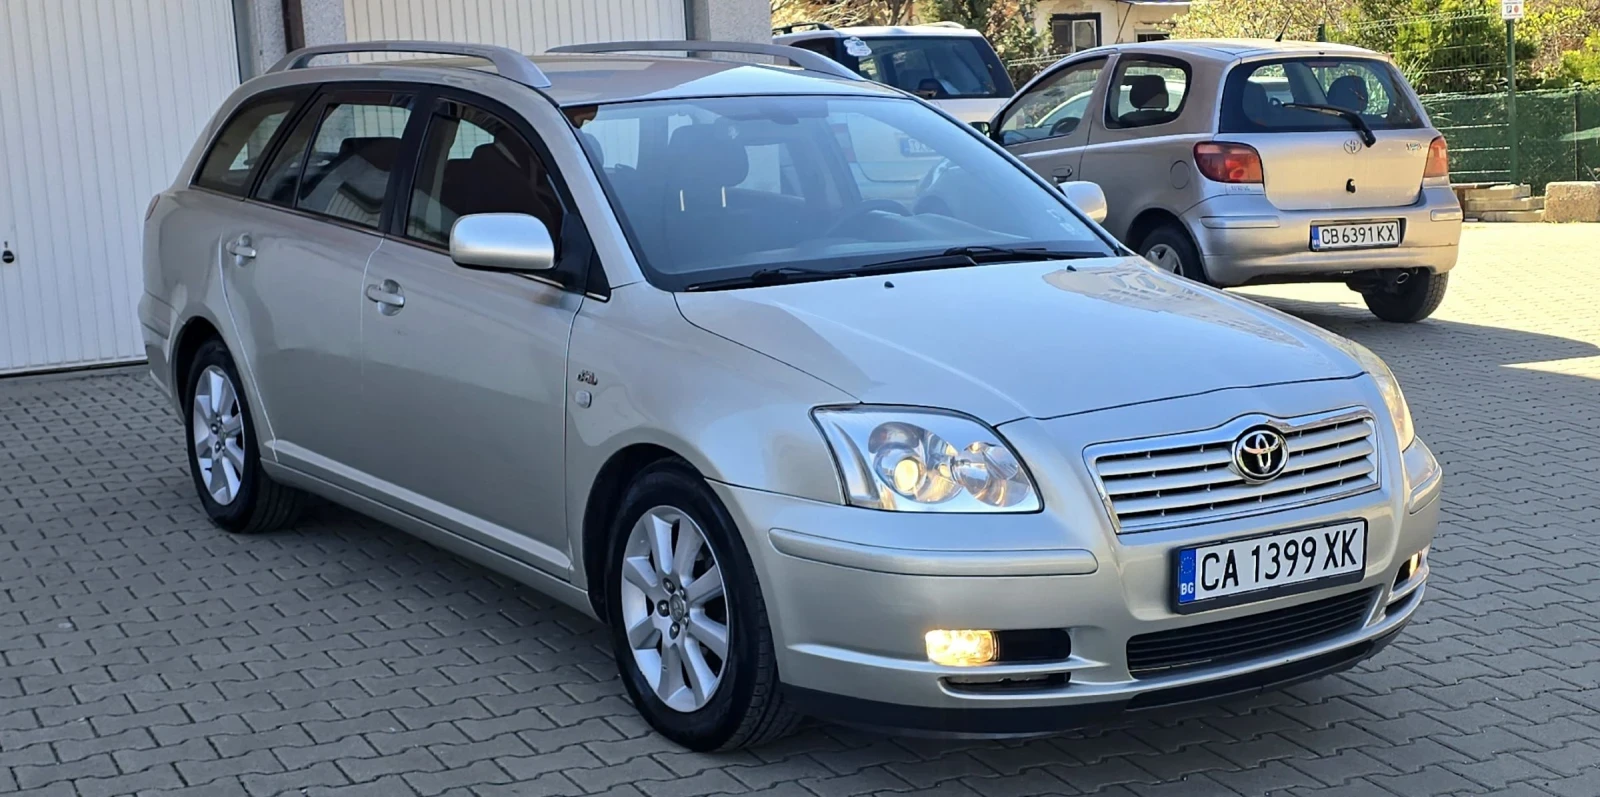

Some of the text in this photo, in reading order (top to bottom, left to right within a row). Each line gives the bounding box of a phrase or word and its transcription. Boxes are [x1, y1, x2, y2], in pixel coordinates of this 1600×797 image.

[1321, 225, 1396, 245] CB 6391 KX
[1181, 528, 1358, 596] BG CA 1399 XK
